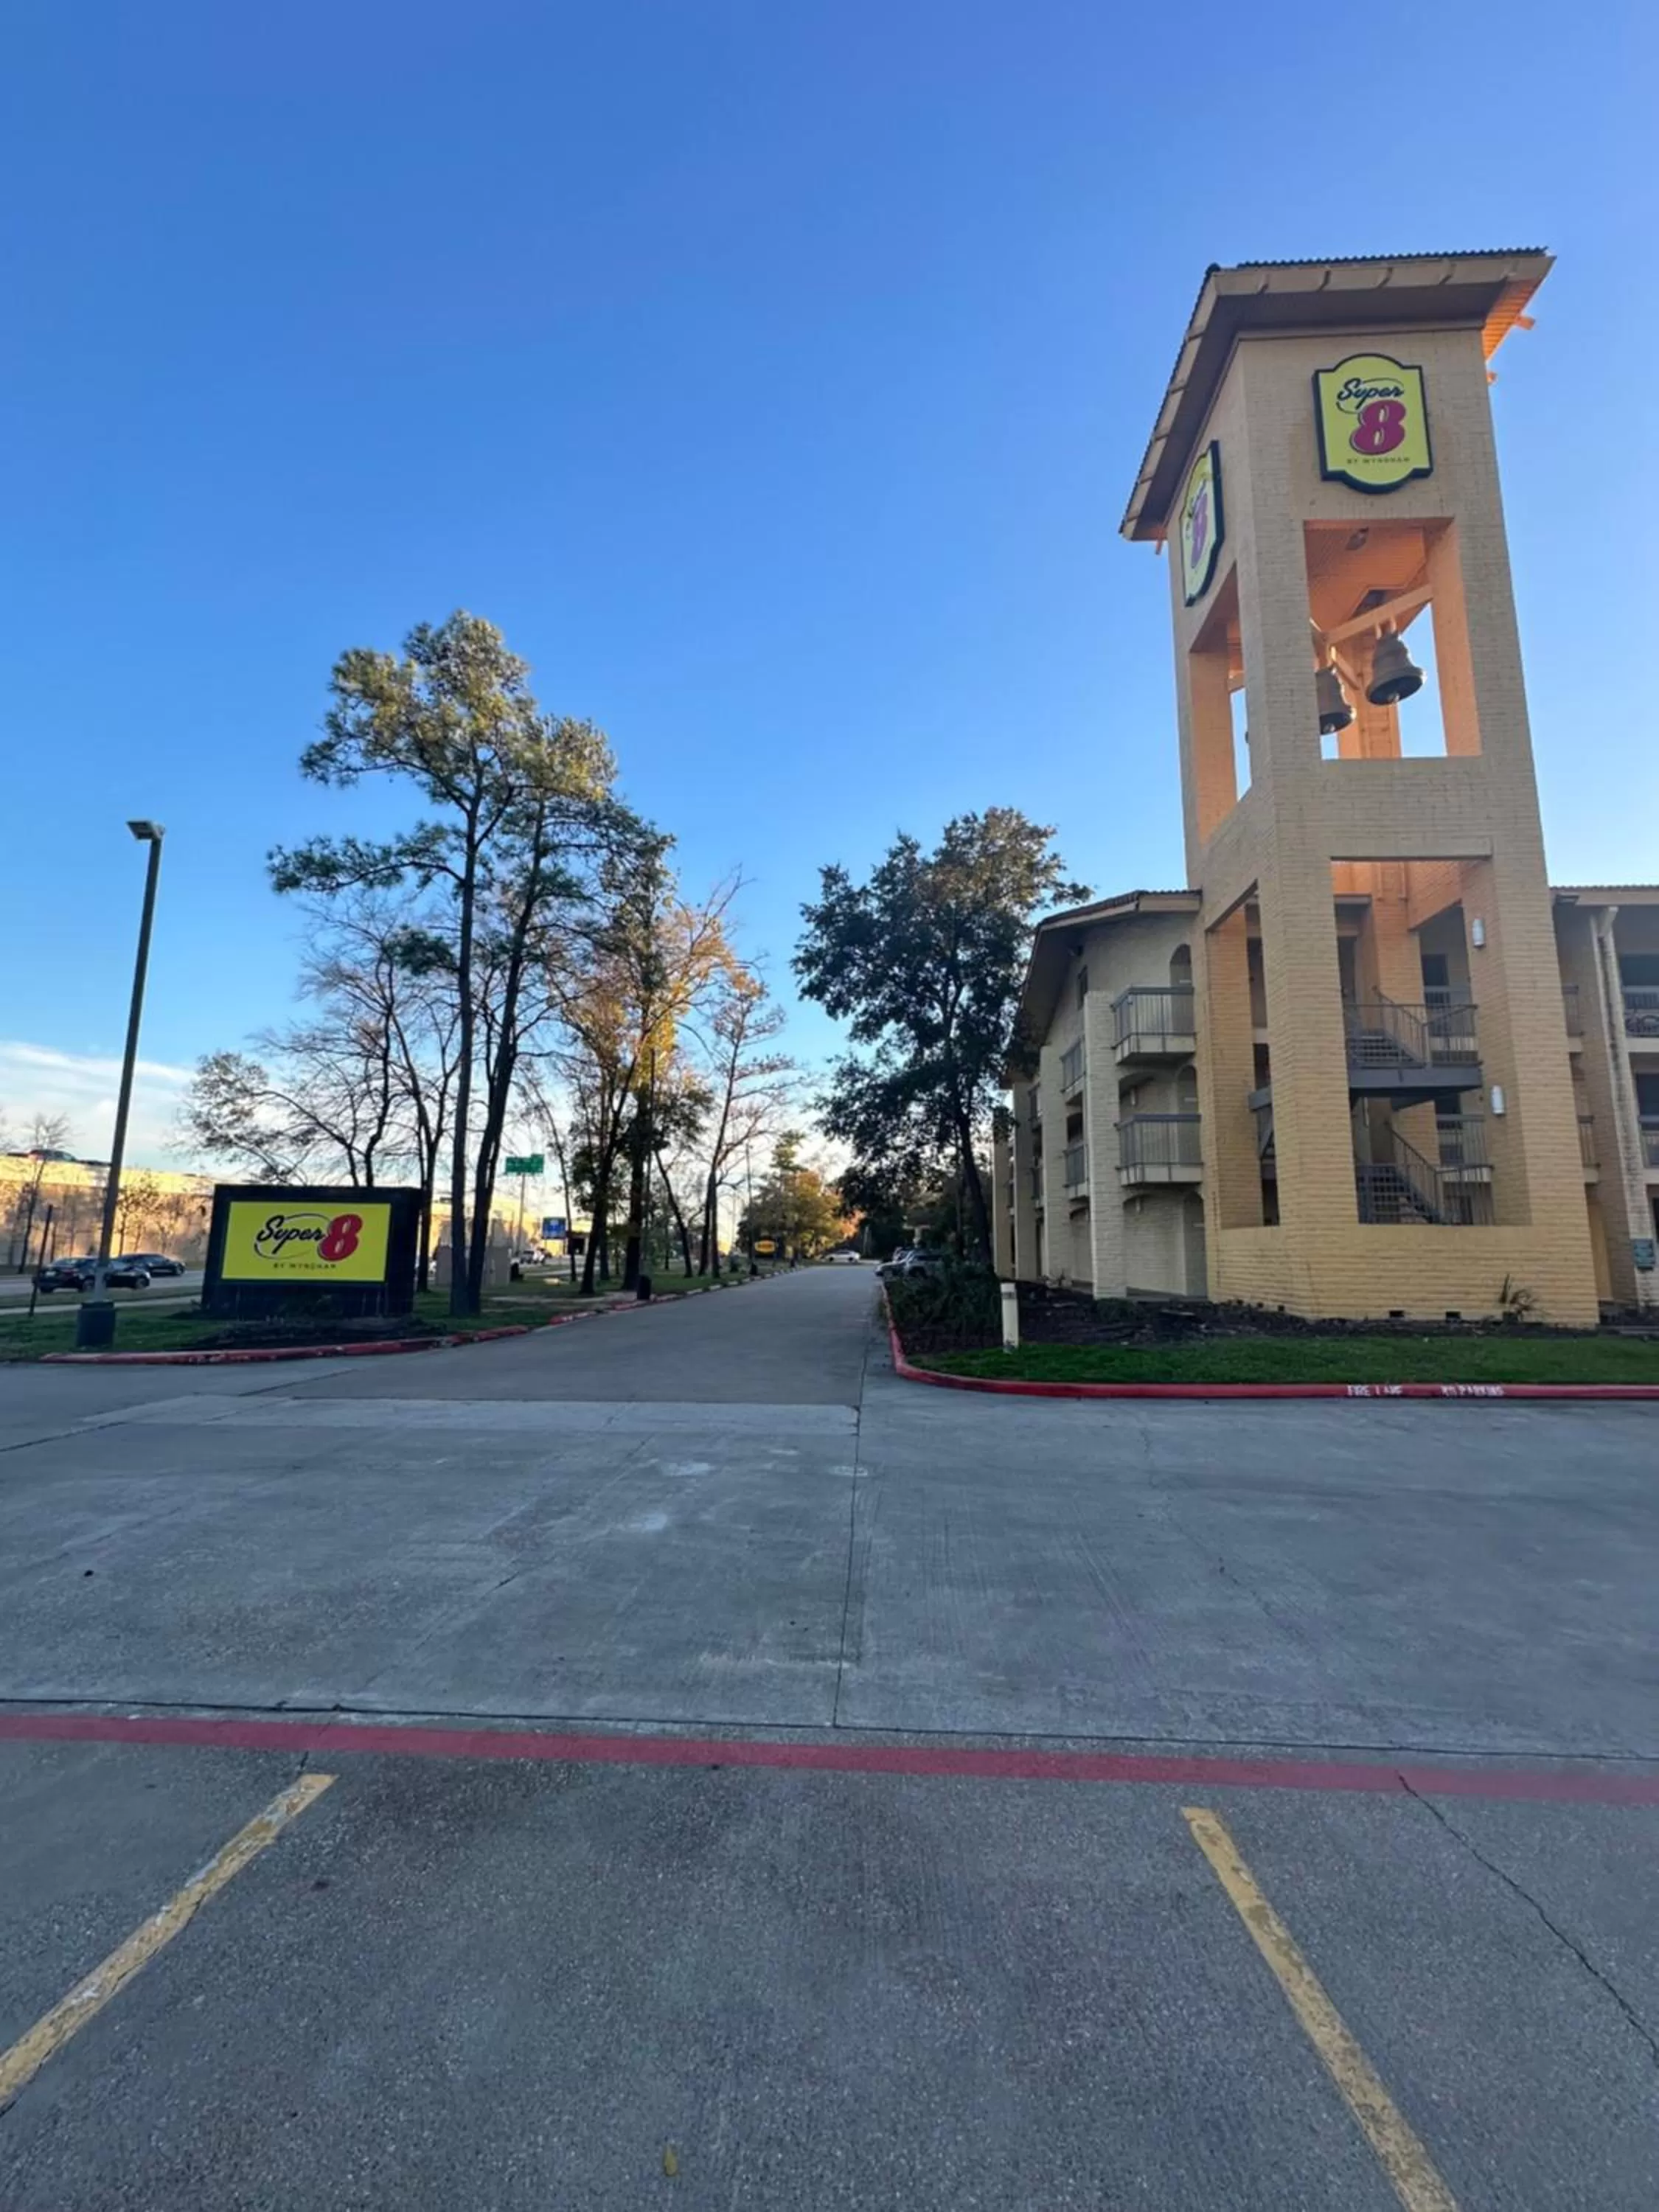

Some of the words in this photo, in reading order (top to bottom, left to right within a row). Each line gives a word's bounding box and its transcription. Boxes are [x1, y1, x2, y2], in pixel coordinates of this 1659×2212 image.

[1337, 378, 1404, 410] Super
[1349, 399, 1407, 456] 8
[257, 1214, 328, 1254] Super
[317, 1213, 363, 1262] 8
